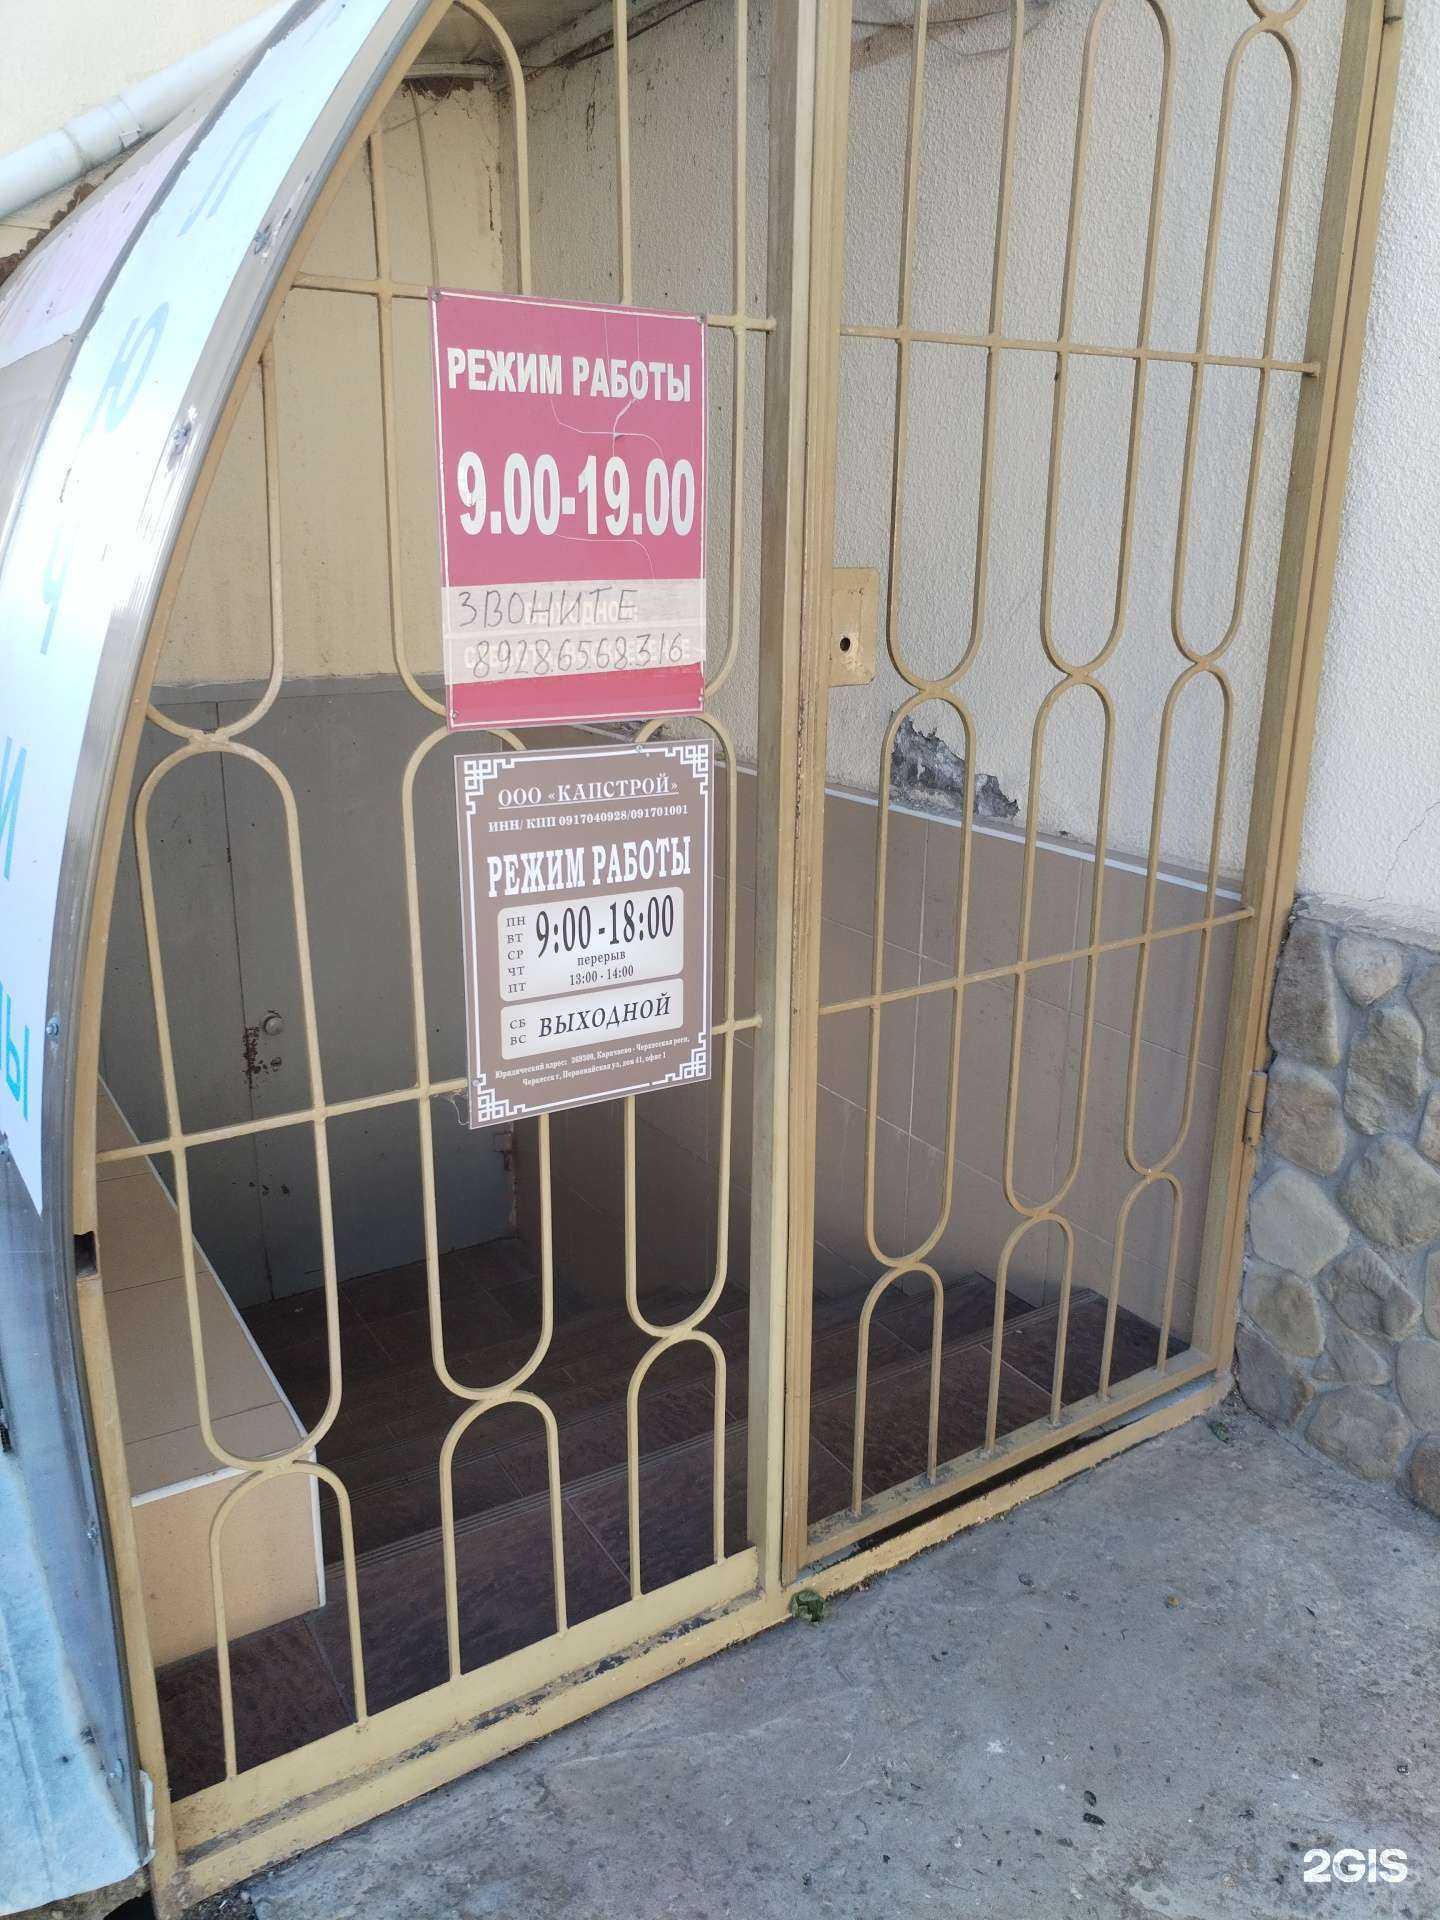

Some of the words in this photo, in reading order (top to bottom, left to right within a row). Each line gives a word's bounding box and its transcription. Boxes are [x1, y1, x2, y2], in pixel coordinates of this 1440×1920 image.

[447, 347, 562, 394] РЕЖИМ
[572, 356, 691, 402] РАБОТЫ
[457, 450, 695, 536] 9.00-19.00
[458, 586, 639, 629] ЗВОНИТЕ
[498, 787, 542, 807] ООО
[548, 772, 680, 802] «КАПСТРОЙ»
[487, 847, 586, 897] РЕЖИМ
[592, 835, 692, 886] РАБОТЫ
[506, 916, 526, 928] ПН
[507, 933, 523, 945] ВТ
[507, 949, 524, 961] СР
[577, 951, 627, 967] перерыв
[507, 966, 525, 977] ЧТ
[507, 982, 527, 994] ПТ
[509, 1017, 526, 1030] СБ
[538, 991, 671, 1038] ВЫХОДНОЙ
[510, 1034, 527, 1046] ВС
